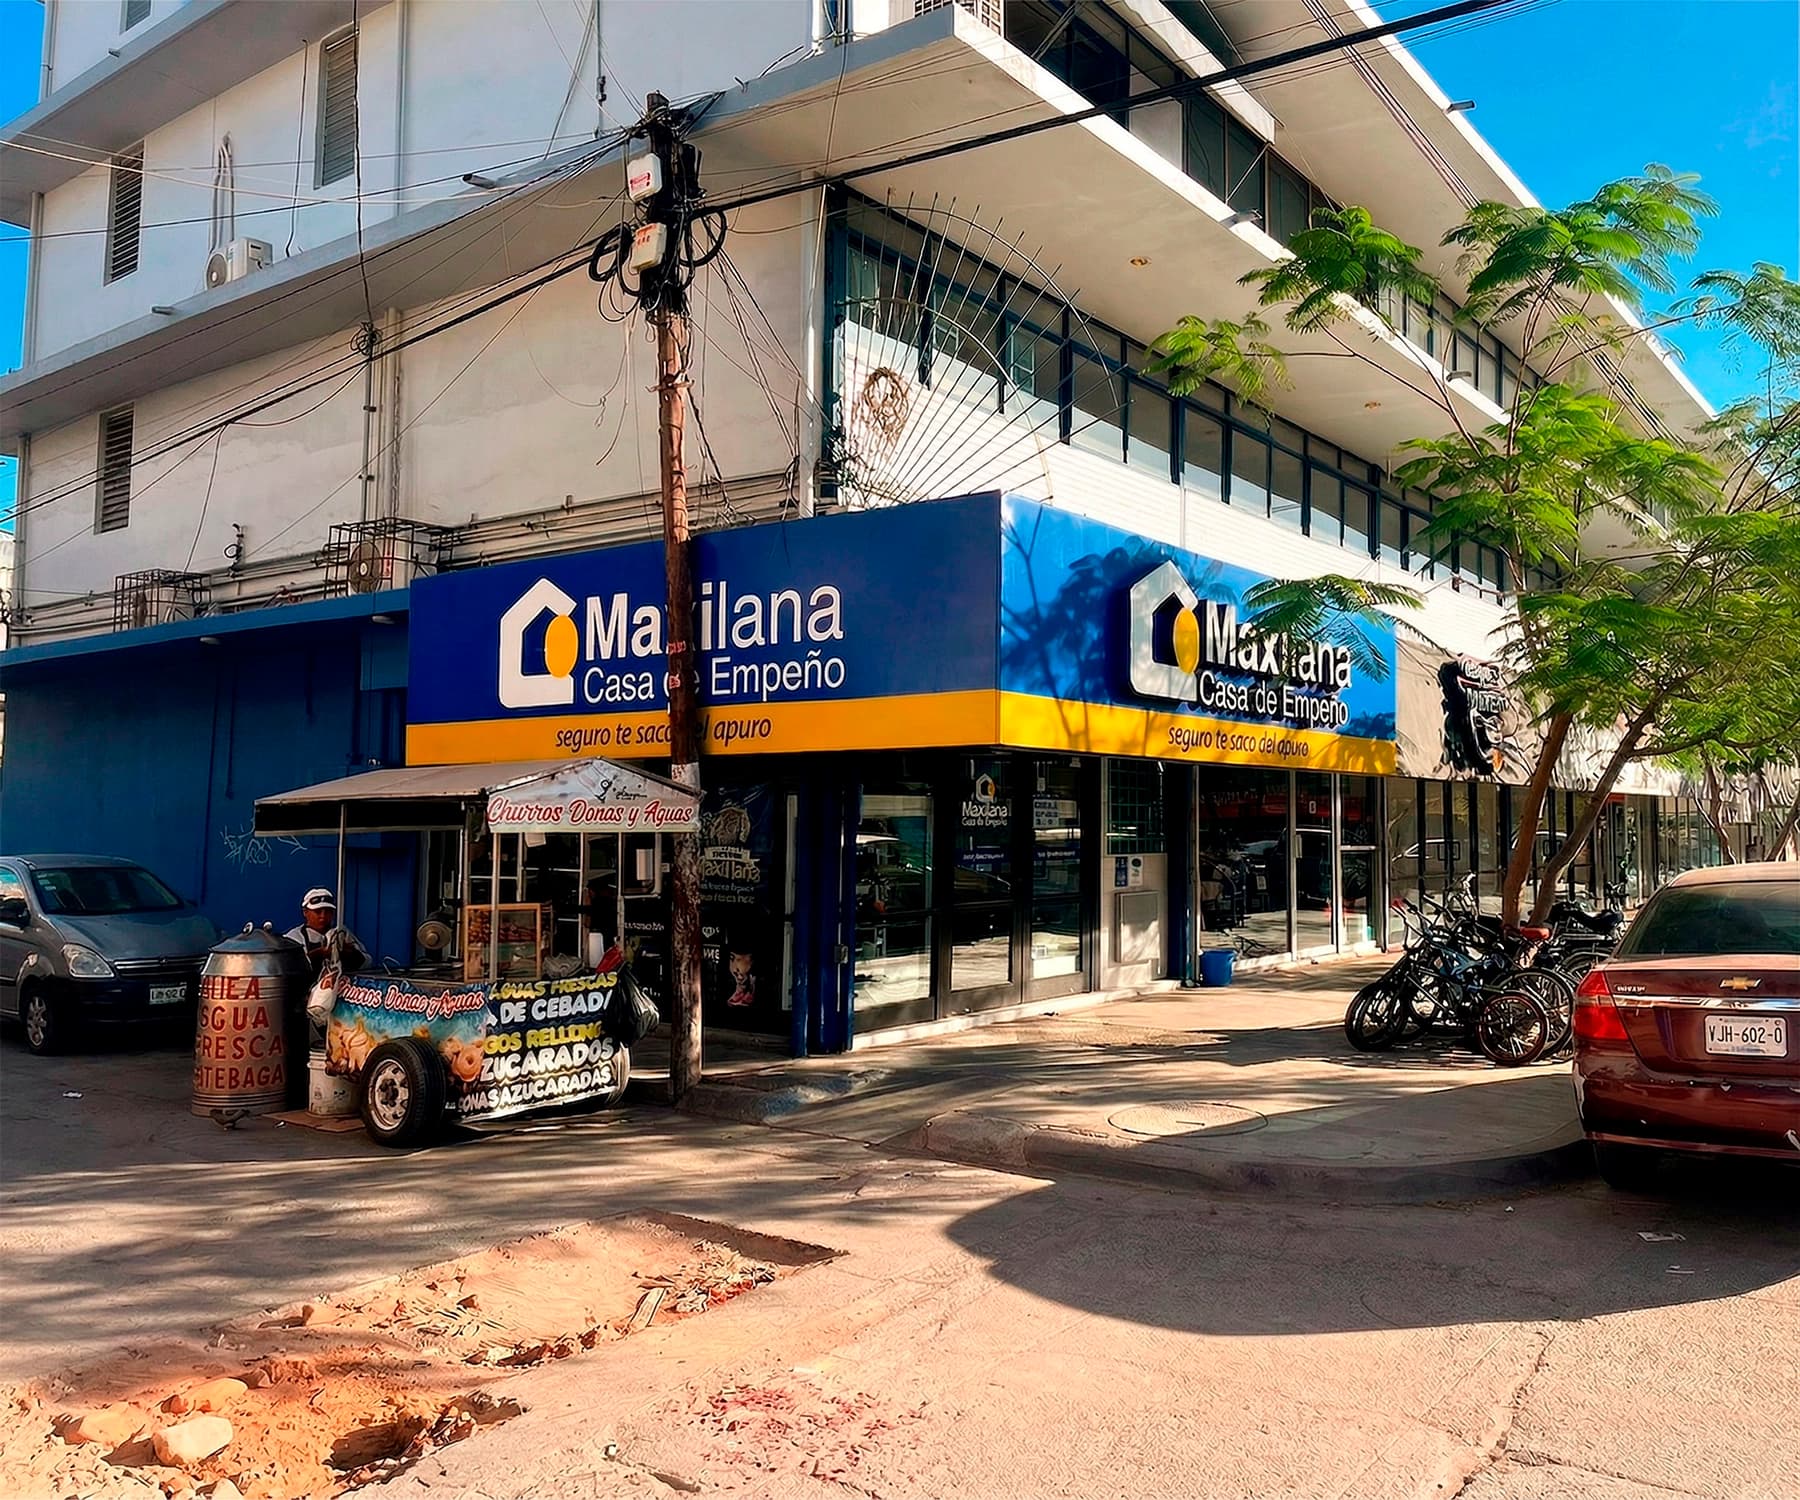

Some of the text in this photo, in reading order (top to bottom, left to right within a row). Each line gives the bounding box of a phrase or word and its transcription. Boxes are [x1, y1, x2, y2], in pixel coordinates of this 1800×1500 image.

[585, 581, 844, 662] Mailana
[584, 667, 655, 704] Casa
[711, 650, 846, 702] Empeño
[1200, 671, 1349, 729] Casa de Empeño
[555, 726, 611, 753] seguro
[615, 722, 632, 745] te
[714, 717, 772, 747] apuro
[1168, 725, 1310, 761] seguro te saco del apuro
[487, 797, 693, 829] Churros Donas y Aguas
[500, 1001, 528, 1025] DE
[480, 1037, 615, 1082] ZUCARADOS
